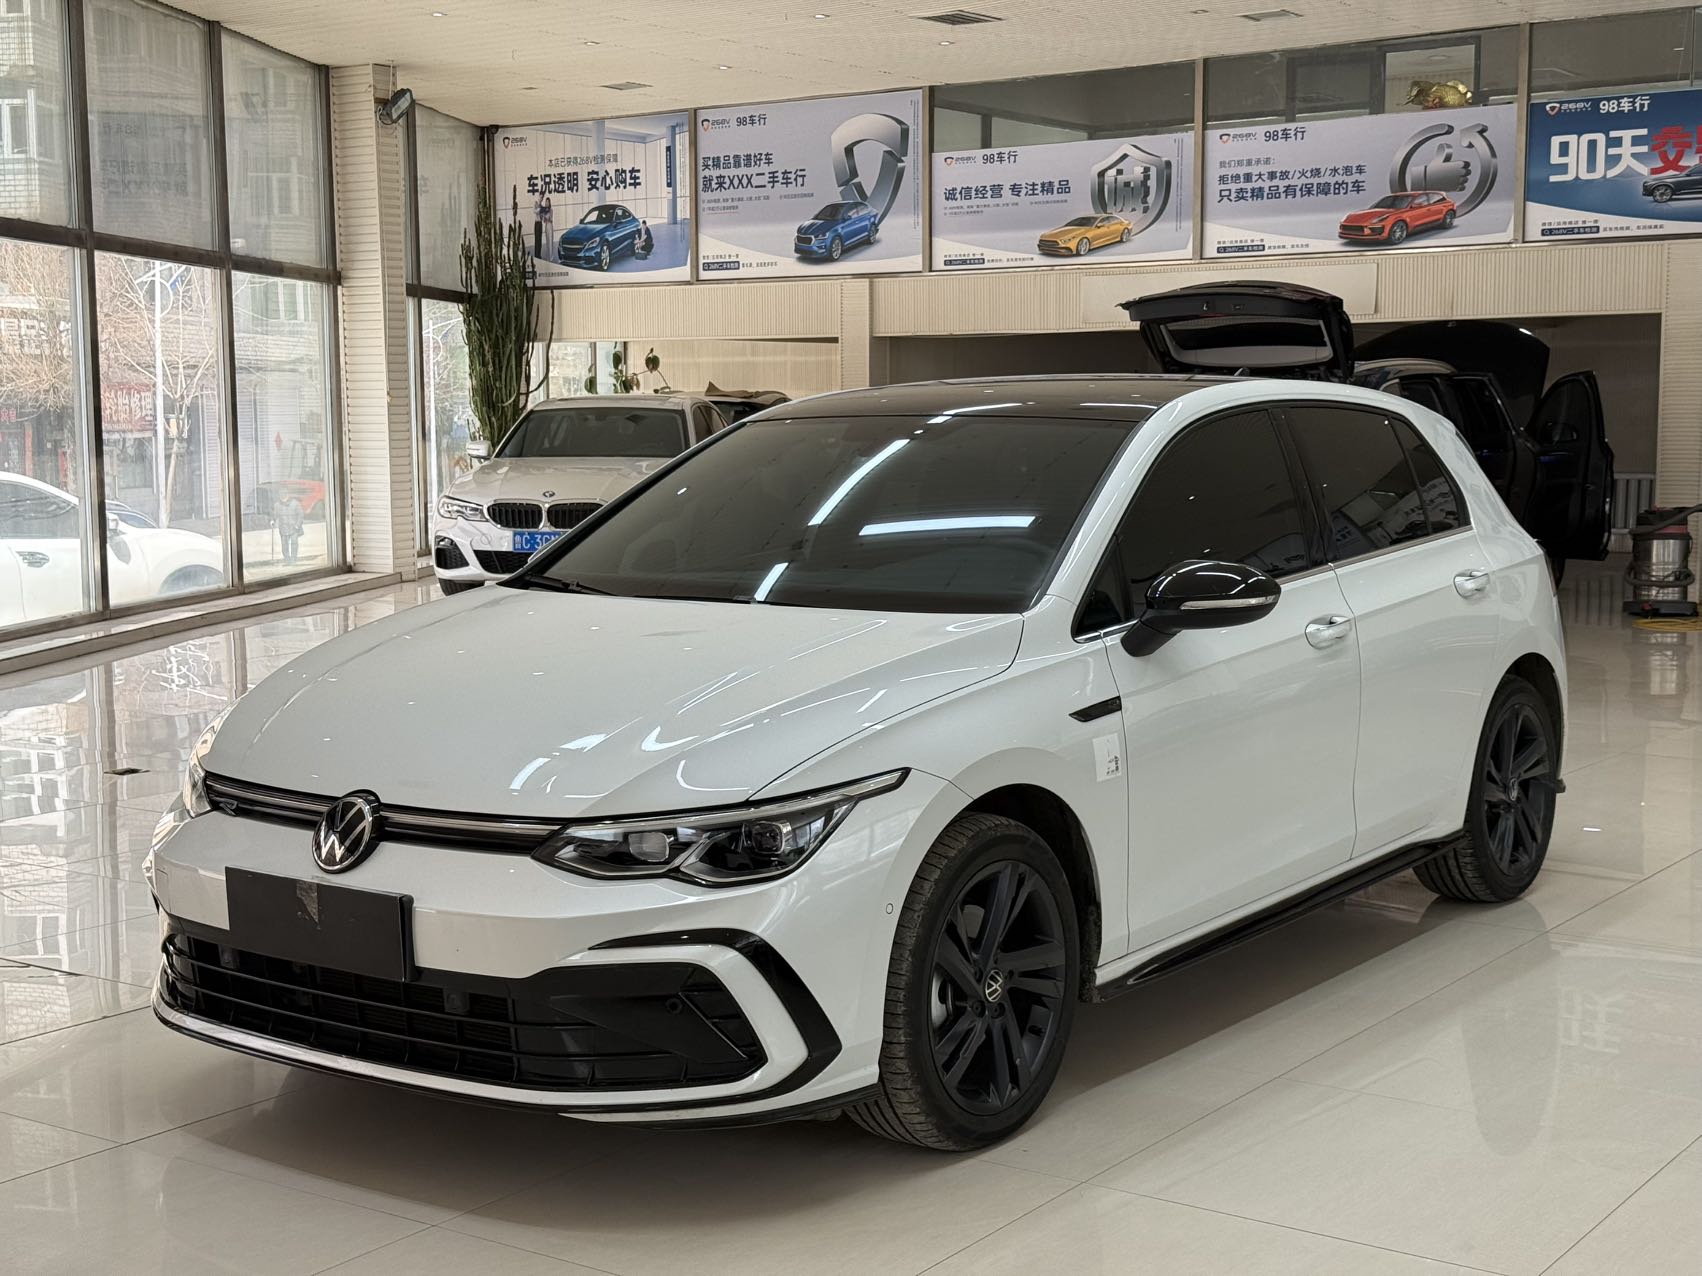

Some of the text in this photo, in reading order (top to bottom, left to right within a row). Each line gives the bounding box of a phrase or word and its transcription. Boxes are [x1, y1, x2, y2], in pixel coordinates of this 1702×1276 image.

[1599, 96, 1650, 113] 98车行
[736, 113, 768, 127] 98车行
[1264, 127, 1306, 142] 98车行
[701, 152, 774, 172] 买精品靠谱好车
[982, 150, 1018, 165] 98车行
[527, 167, 642, 196] 车况透明 安心购车
[701, 168, 807, 193] 就来XXX二手车行
[1218, 164, 1367, 186] 拒绝重大事故/火烧/水泡车
[943, 179, 1072, 202] 诚信经营 专注精品
[1217, 179, 1366, 203] 只卖精品有保障的车
